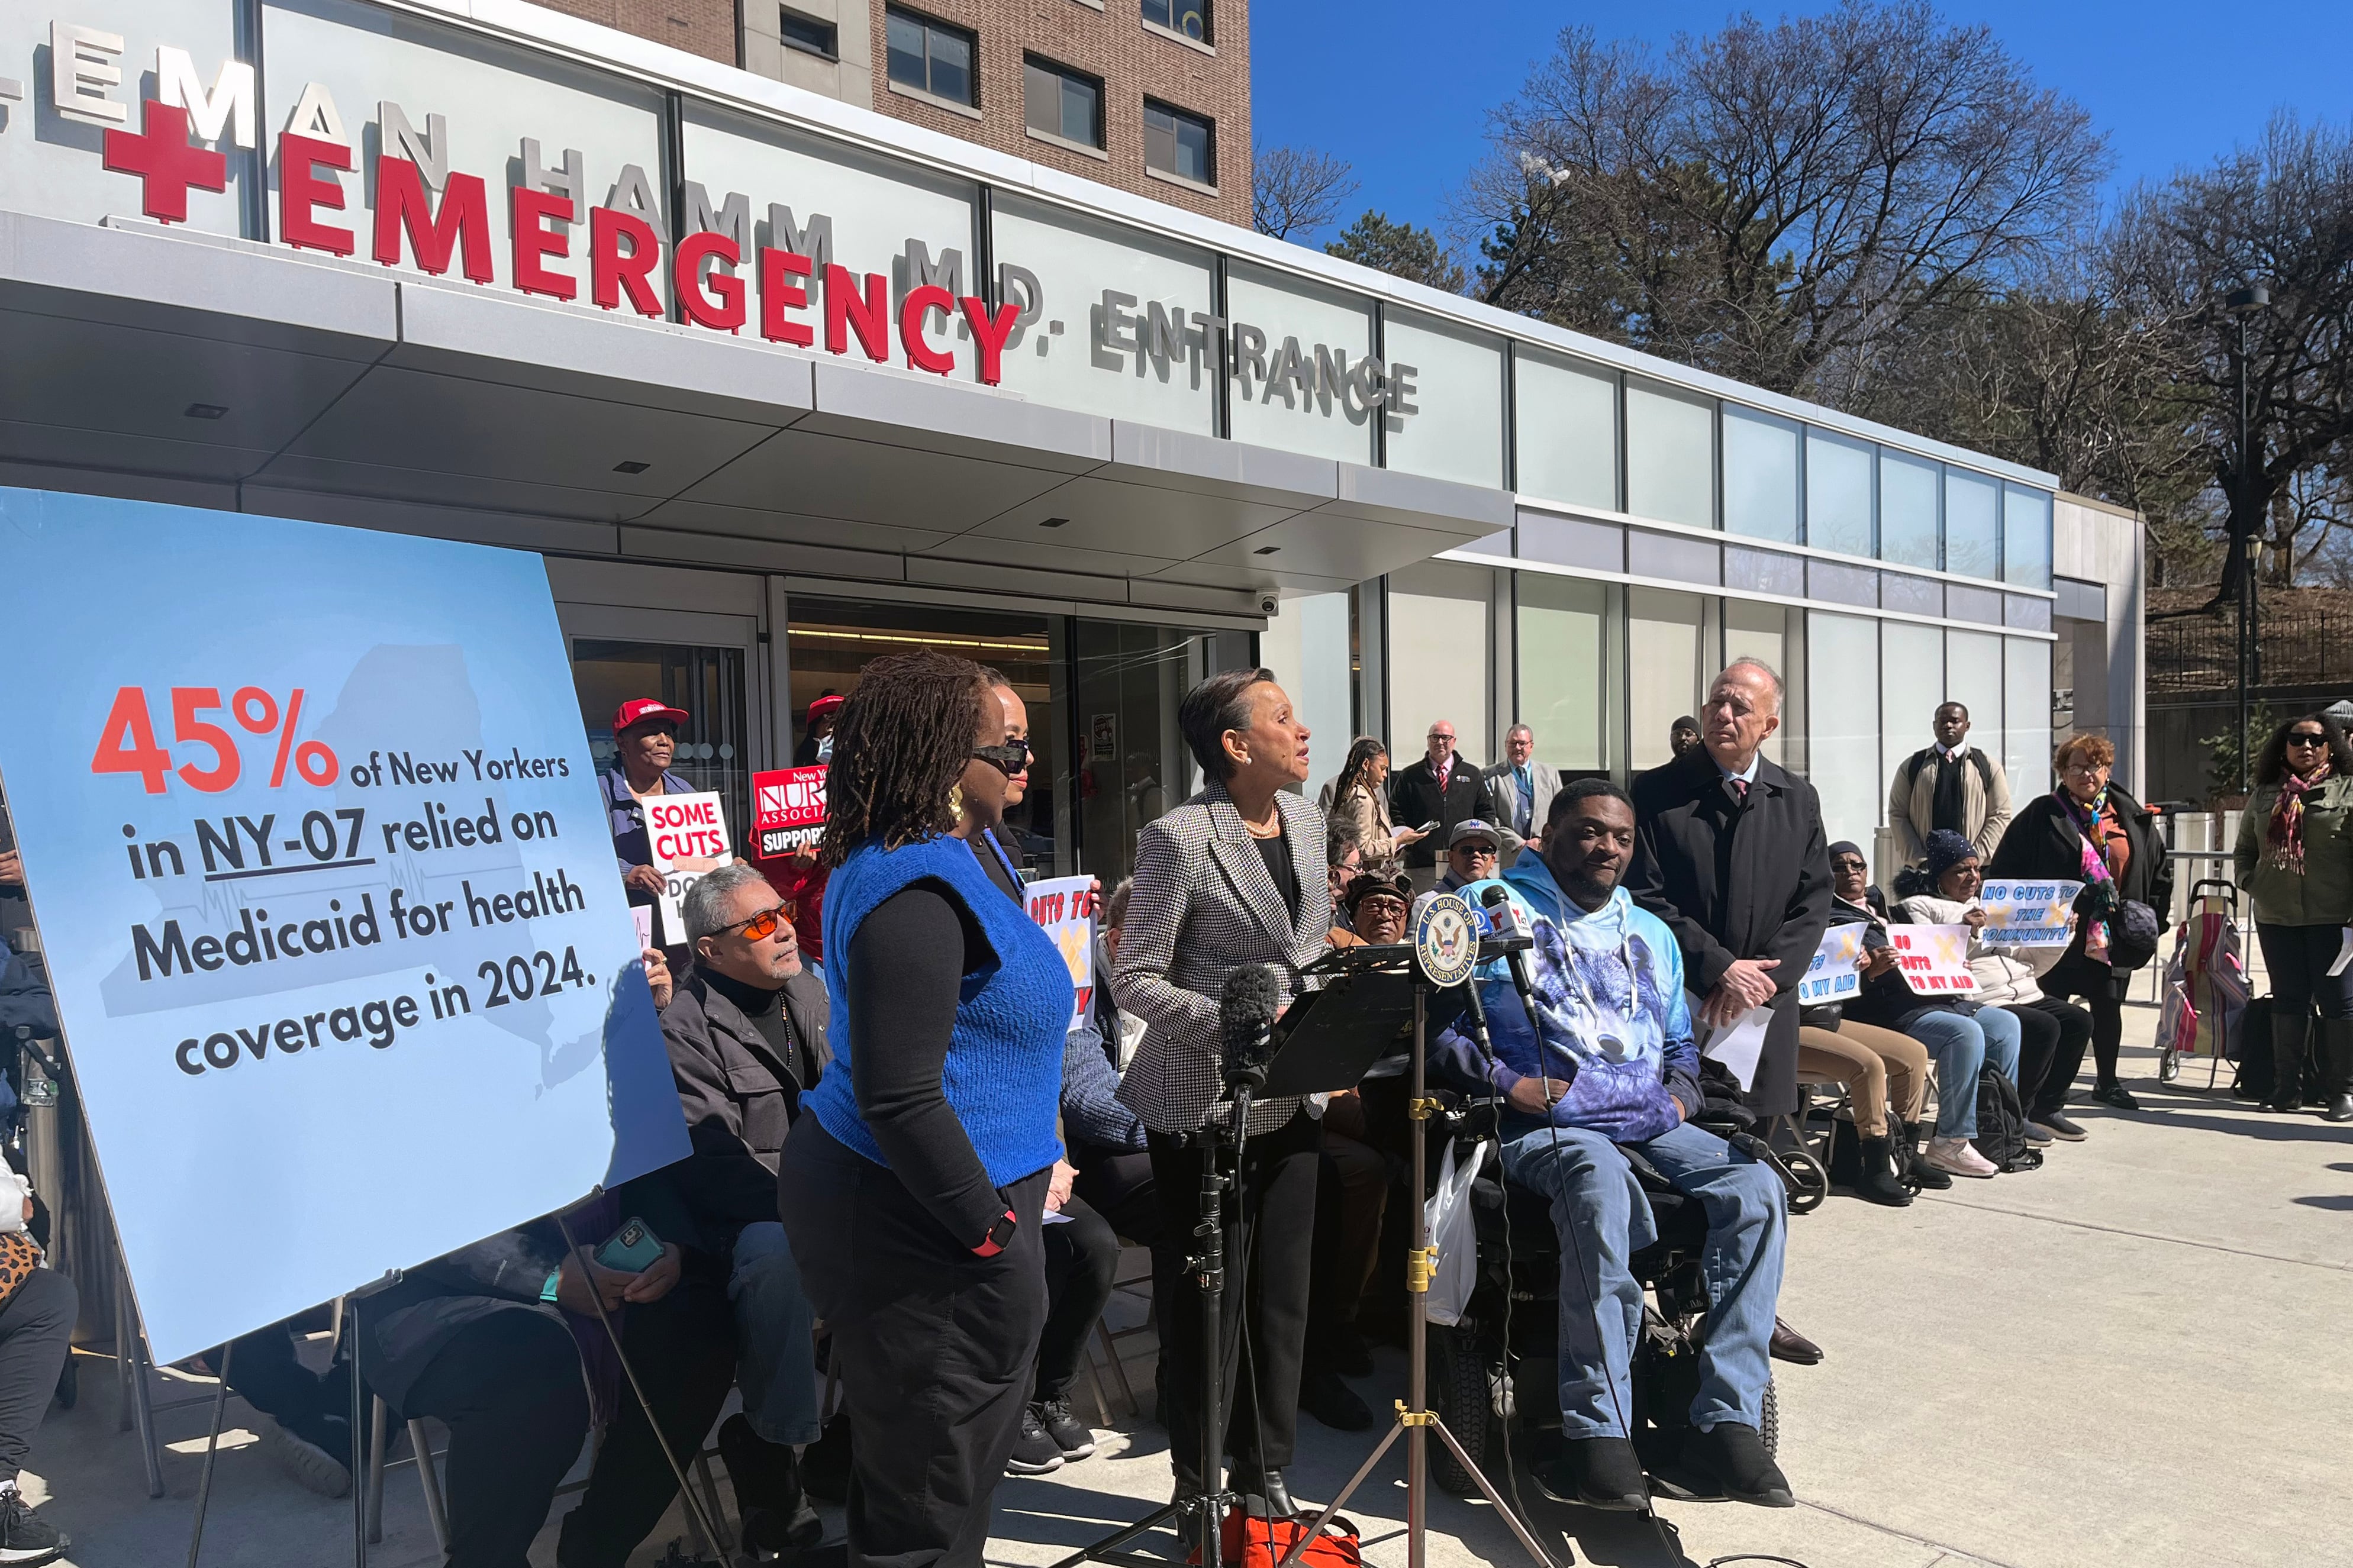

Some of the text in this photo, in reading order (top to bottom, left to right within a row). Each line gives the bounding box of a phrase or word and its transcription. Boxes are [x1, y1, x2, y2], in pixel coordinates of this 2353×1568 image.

[0, 20, 447, 193] EMAN
[905, 238, 1064, 335] MD.
[1103, 288, 1419, 416] ENTRANCE
[279, 131, 1021, 385] EMERGENCY
[91, 686, 570, 794] 45% of New Yorkers
[793, 771, 816, 782] New
[759, 780, 827, 812] NUR
[652, 802, 717, 829] SOME
[123, 798, 558, 879] in NY-07 relied on
[656, 830, 724, 860] CUTS
[668, 876, 704, 898] DO
[1983, 886, 2079, 901] NO CUTS TO
[1031, 892, 1065, 927] CUTS
[1071, 891, 1091, 920] TO
[1423, 898, 1474, 927] U.S. HOUSE OF
[2015, 908, 2046, 921] THE
[132, 869, 585, 981] Medicaid for health
[1893, 934, 1911, 950] NO
[1420, 941, 1476, 981] REPRESENTATIVES
[1900, 956, 1932, 970] CUTS
[1812, 978, 1830, 996] MY
[1835, 974, 1856, 993] AID
[1909, 975, 1974, 989] TO MY AID
[176, 946, 596, 1075] coverage in 2024.
